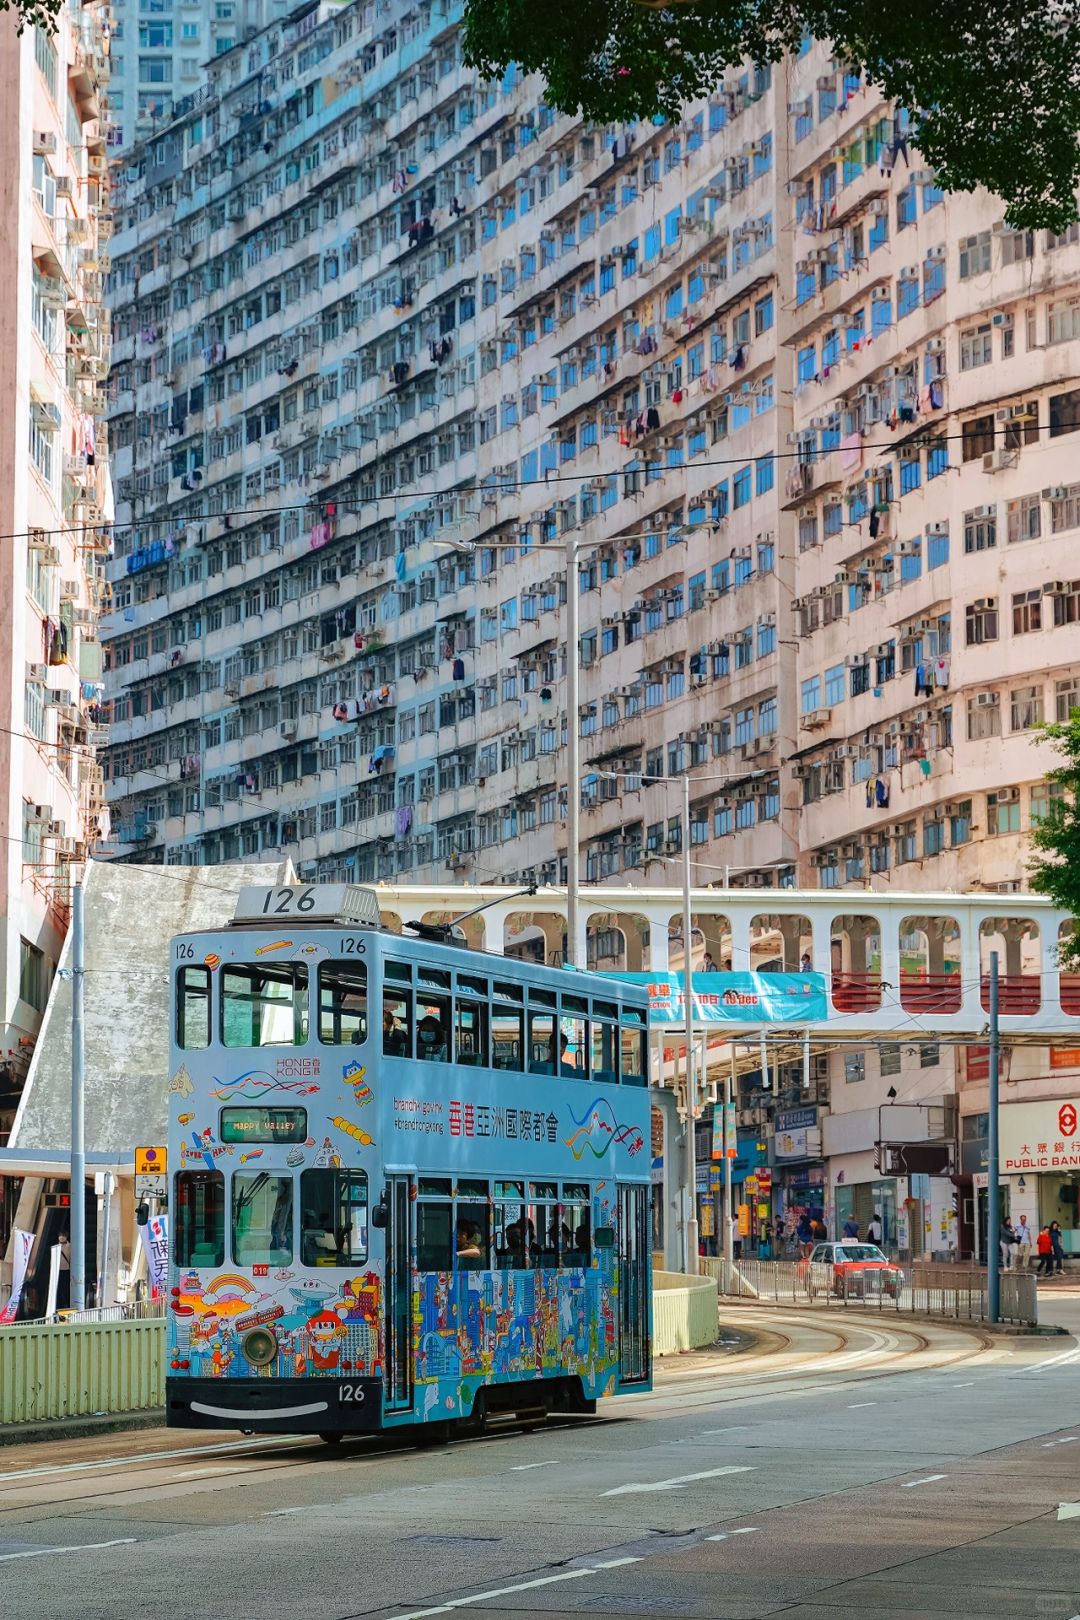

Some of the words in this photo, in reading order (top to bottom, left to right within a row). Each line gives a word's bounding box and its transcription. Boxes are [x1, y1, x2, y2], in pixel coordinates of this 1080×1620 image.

[262, 887, 316, 914] 126
[176, 943, 194, 959] 126
[340, 938, 366, 954] 126
[277, 1058, 311, 1067] HONG
[277, 1067, 311, 1076] KONG
[233, 1121, 260, 1131] Happy
[264, 1121, 296, 1131] Valley
[449, 1100, 559, 1143] 香港亞洲國際都會
[1006, 1157, 1048, 1168] PUBLIC
[1052, 1156, 1080, 1165] BAN
[339, 1384, 365, 1402] 126
